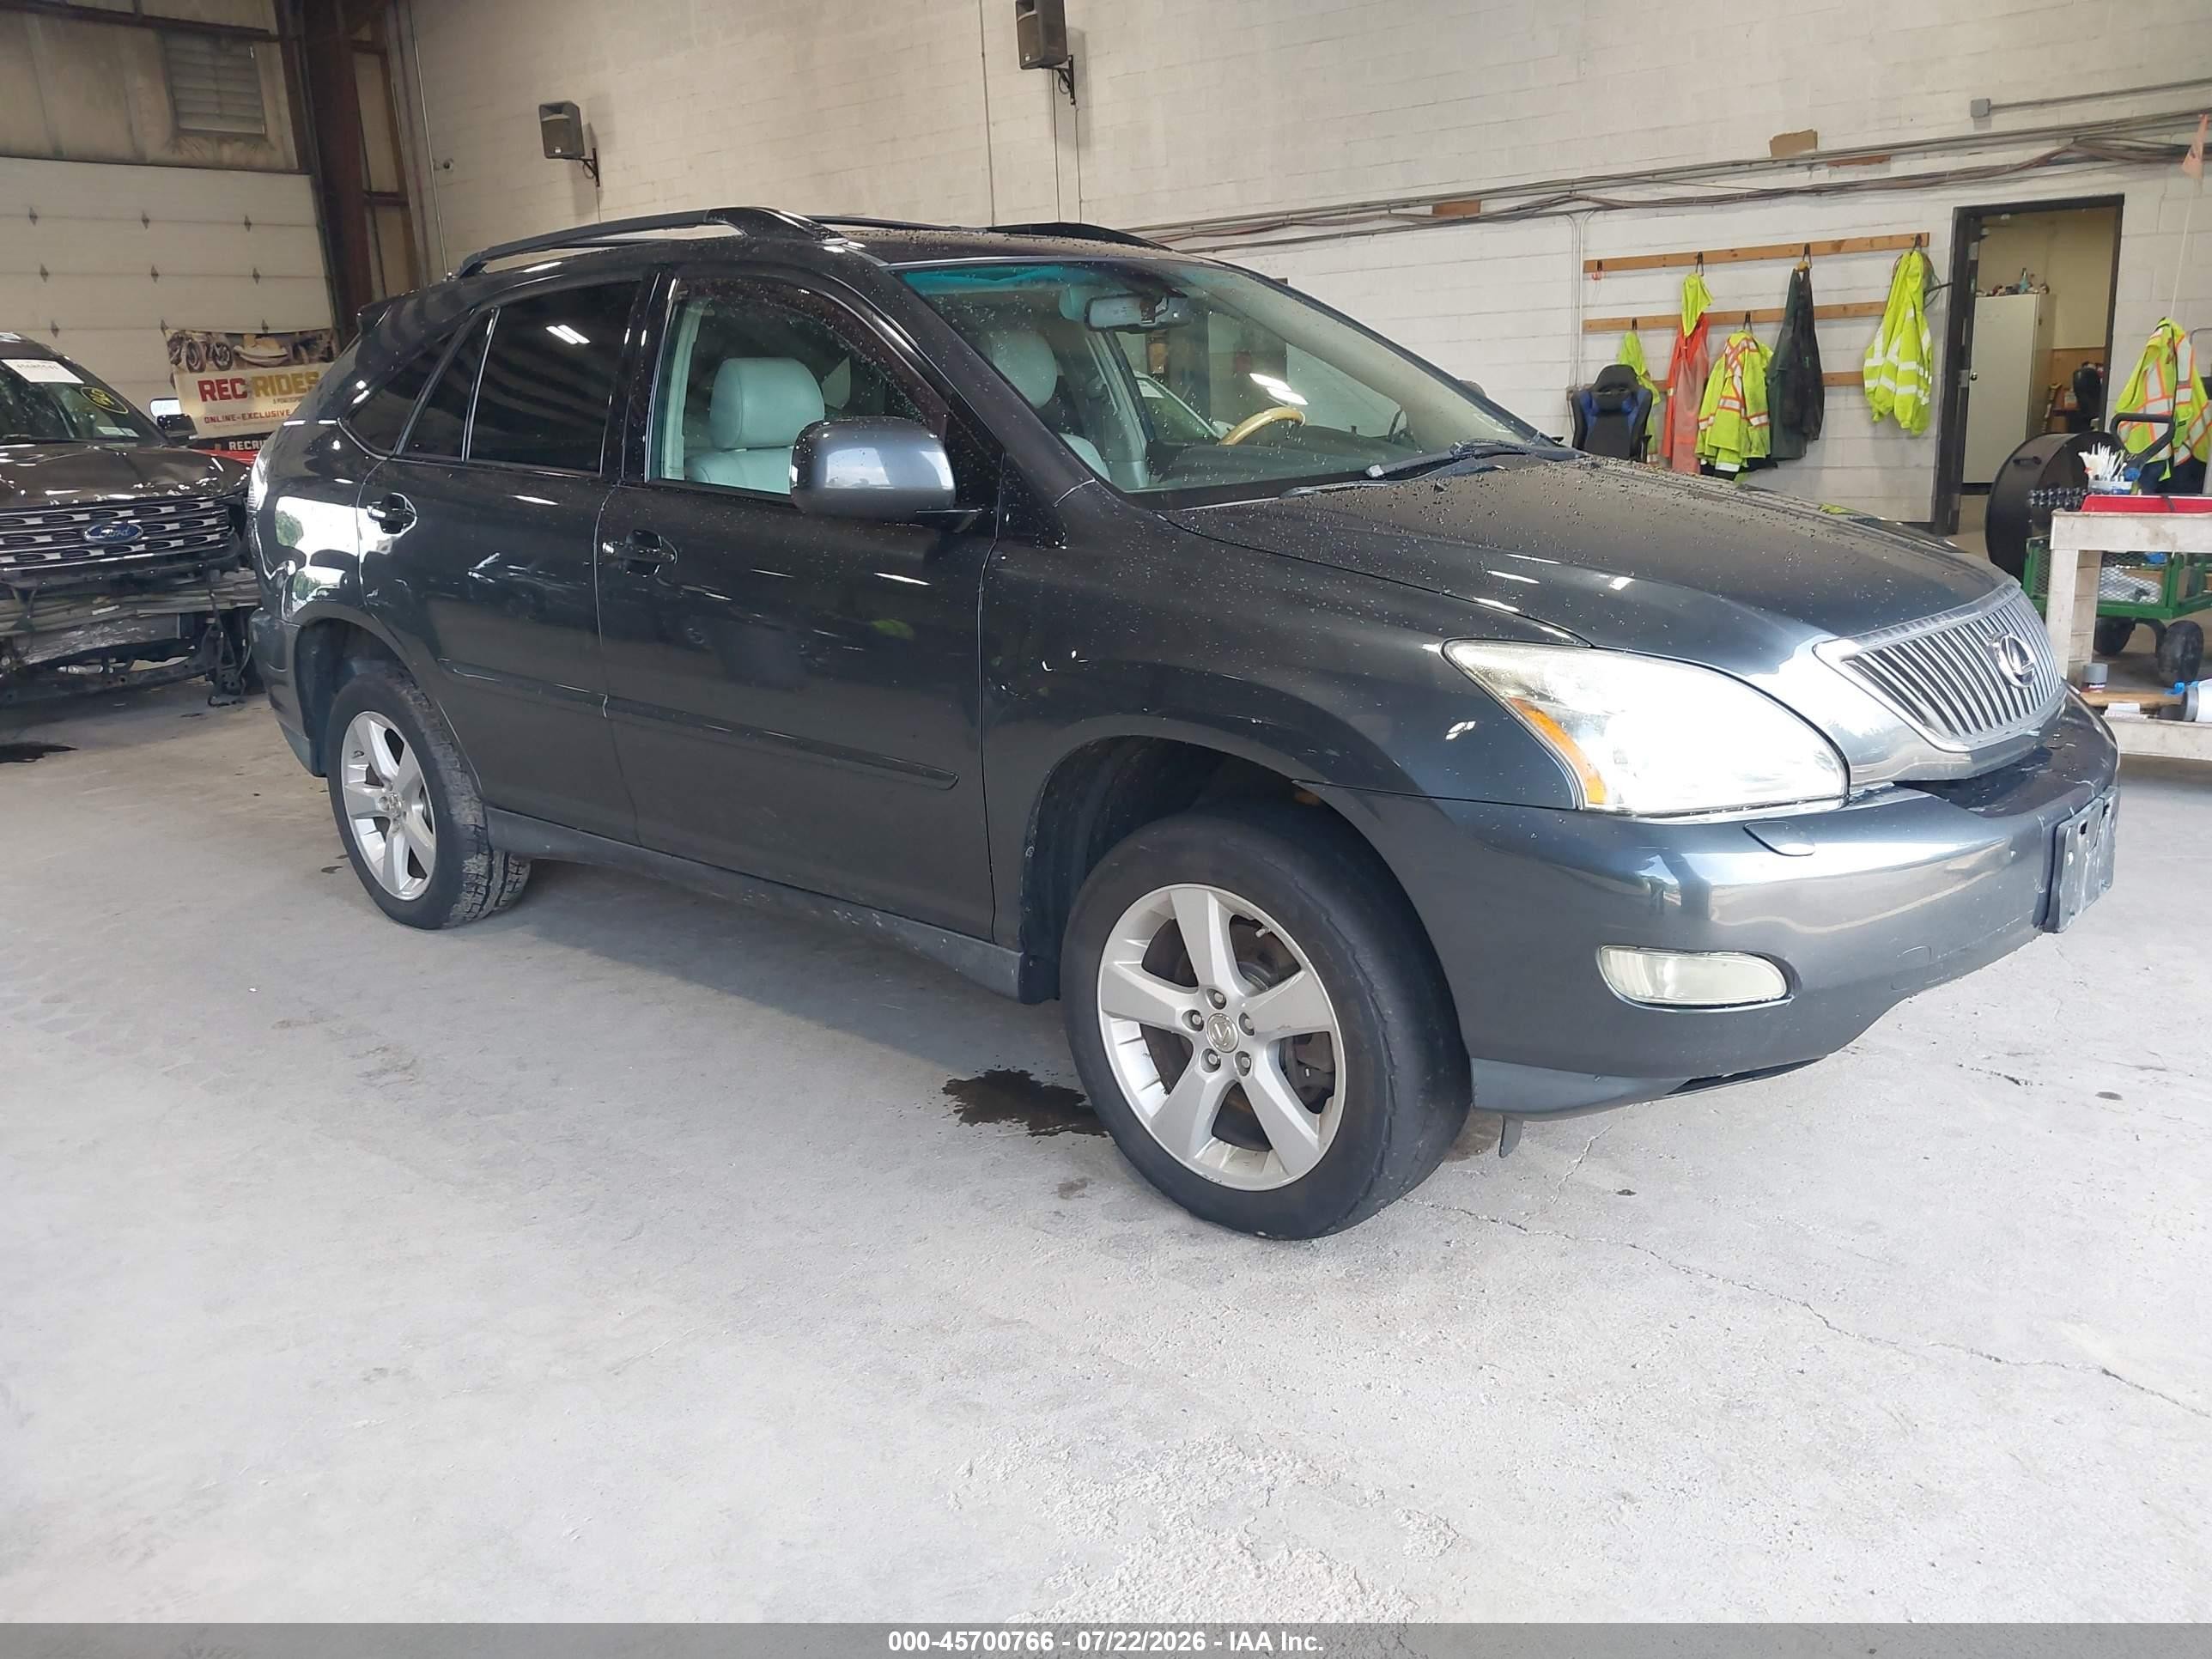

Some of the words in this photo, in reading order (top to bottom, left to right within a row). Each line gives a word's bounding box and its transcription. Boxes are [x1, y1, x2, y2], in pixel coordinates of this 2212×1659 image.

[198, 377, 248, 402] REC
[252, 371, 319, 398] RIDES
[204, 409, 290, 424] ONLINE-EXCLUSIVE
